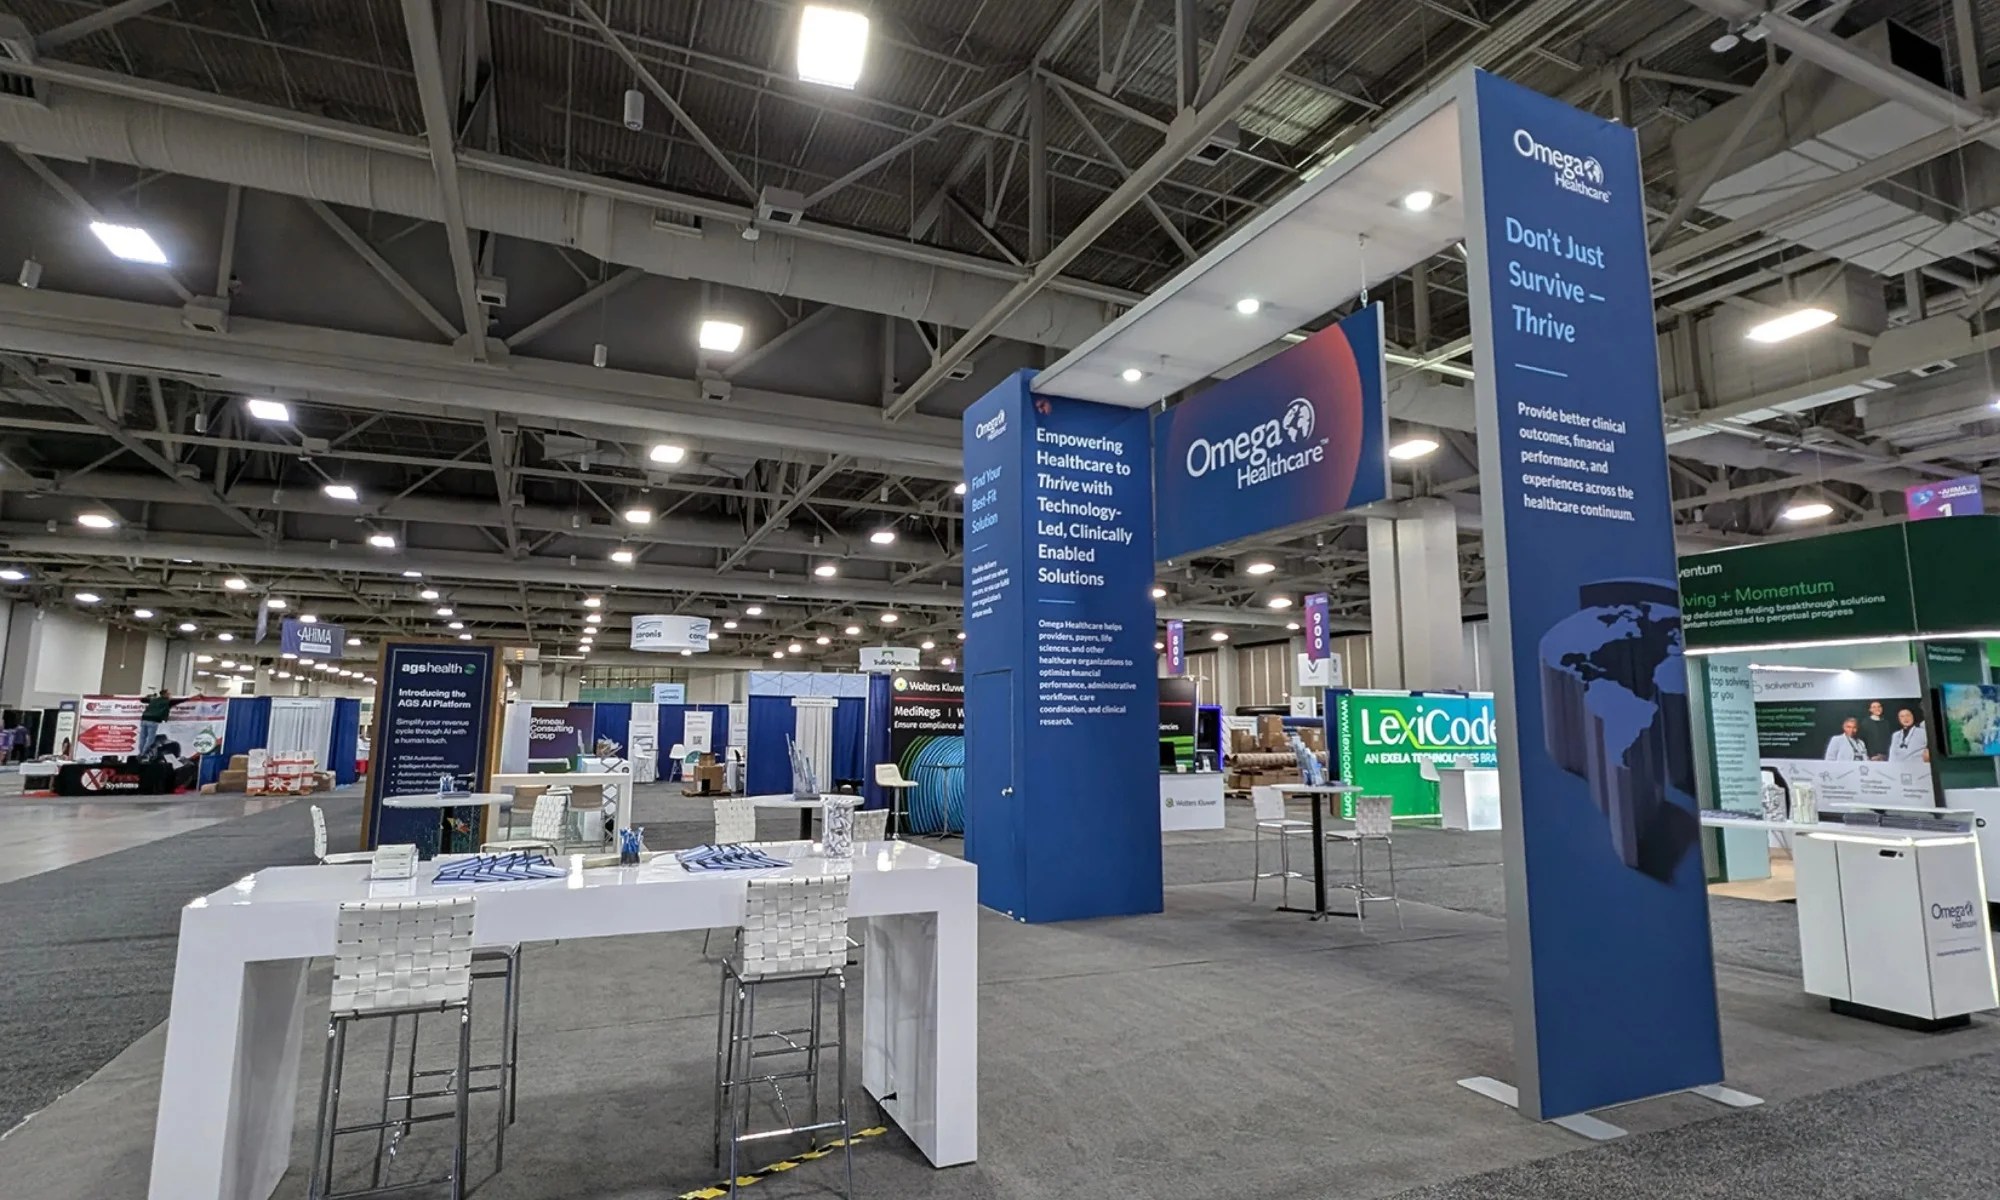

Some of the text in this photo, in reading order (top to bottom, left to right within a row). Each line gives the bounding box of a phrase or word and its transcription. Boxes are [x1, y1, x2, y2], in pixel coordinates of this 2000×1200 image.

[1514, 129, 1584, 180] Omega
[1555, 171, 1609, 203] Healthcare
[1506, 216, 1605, 268] Don't Just
[1508, 262, 1585, 303] Survive
[1512, 304, 1576, 343] Thrive
[1518, 401, 1626, 434] Provide better clinical
[1037, 427, 1123, 456] Empowering
[1186, 419, 1283, 478] Omega
[1519, 428, 1615, 453] outcomes, financial
[1037, 450, 1131, 476] Healthcare to
[1237, 445, 1324, 489] Healthcare
[1521, 450, 1608, 473] performance, and
[972, 465, 1001, 491] Find Your
[1037, 473, 1112, 496] Thrive with
[1522, 473, 1634, 499] experiences across the
[1037, 497, 1122, 521] Technology-
[1524, 494, 1635, 521] healthcare continuum.
[1938, 503, 1952, 516] 1
[972, 513, 998, 533] Solution
[1038, 520, 1132, 545] Led, Clinically
[1038, 544, 1094, 562] Enabled
[1038, 567, 1104, 586] Solutions
[1679, 563, 1722, 577] ventum
[1682, 593, 1716, 608] lving
[1735, 581, 1834, 602] Momentum
[1693, 609, 1733, 619] dedicated
[1745, 606, 1775, 614] finding
[1776, 599, 1838, 612] breakthrough
[1840, 595, 1885, 605] solutions
[1039, 619, 1122, 631] Omega Healthcare helps
[1709, 616, 1754, 627] committed
[1755, 615, 1765, 623] to
[1766, 611, 1810, 623] perpetual
[1811, 608, 1854, 619] progress
[1039, 633, 1074, 641] providers,
[1101, 634, 1113, 642] life
[1313, 612, 1322, 649] 900
[1039, 644, 1070, 653] sciences,
[1072, 645, 1084, 653] and
[1039, 656, 1076, 664] healthcare
[1078, 658, 1124, 666] organizations
[1039, 669, 1070, 678] optimize
[908, 681, 964, 692] Wolters Kluwe
[1039, 681, 1087, 689] performance,
[1711, 677, 1749, 689] top solving
[1764, 681, 1814, 690] solventum
[399, 688, 466, 698] Introducing the
[1039, 693, 1078, 701] workflows,
[1721, 691, 1734, 701] you
[397, 700, 419, 708] AGS
[433, 700, 471, 708] Platform
[894, 706, 941, 719] MediRegs
[1040, 705, 1087, 713] coordination,
[1088, 705, 1100, 713] and
[396, 719, 424, 727] Simplify
[425, 720, 440, 728] your
[530, 717, 565, 725] Primeau
[530, 725, 574, 734] Consulting
[919, 722, 956, 730] compliance
[1040, 717, 1073, 725] research.
[1364, 753, 1379, 764] AN
[1380, 753, 1411, 764] EXELA
[1480, 753, 1497, 763] BRA
[105, 782, 139, 790] Systems
[1931, 903, 1965, 921] Omega
